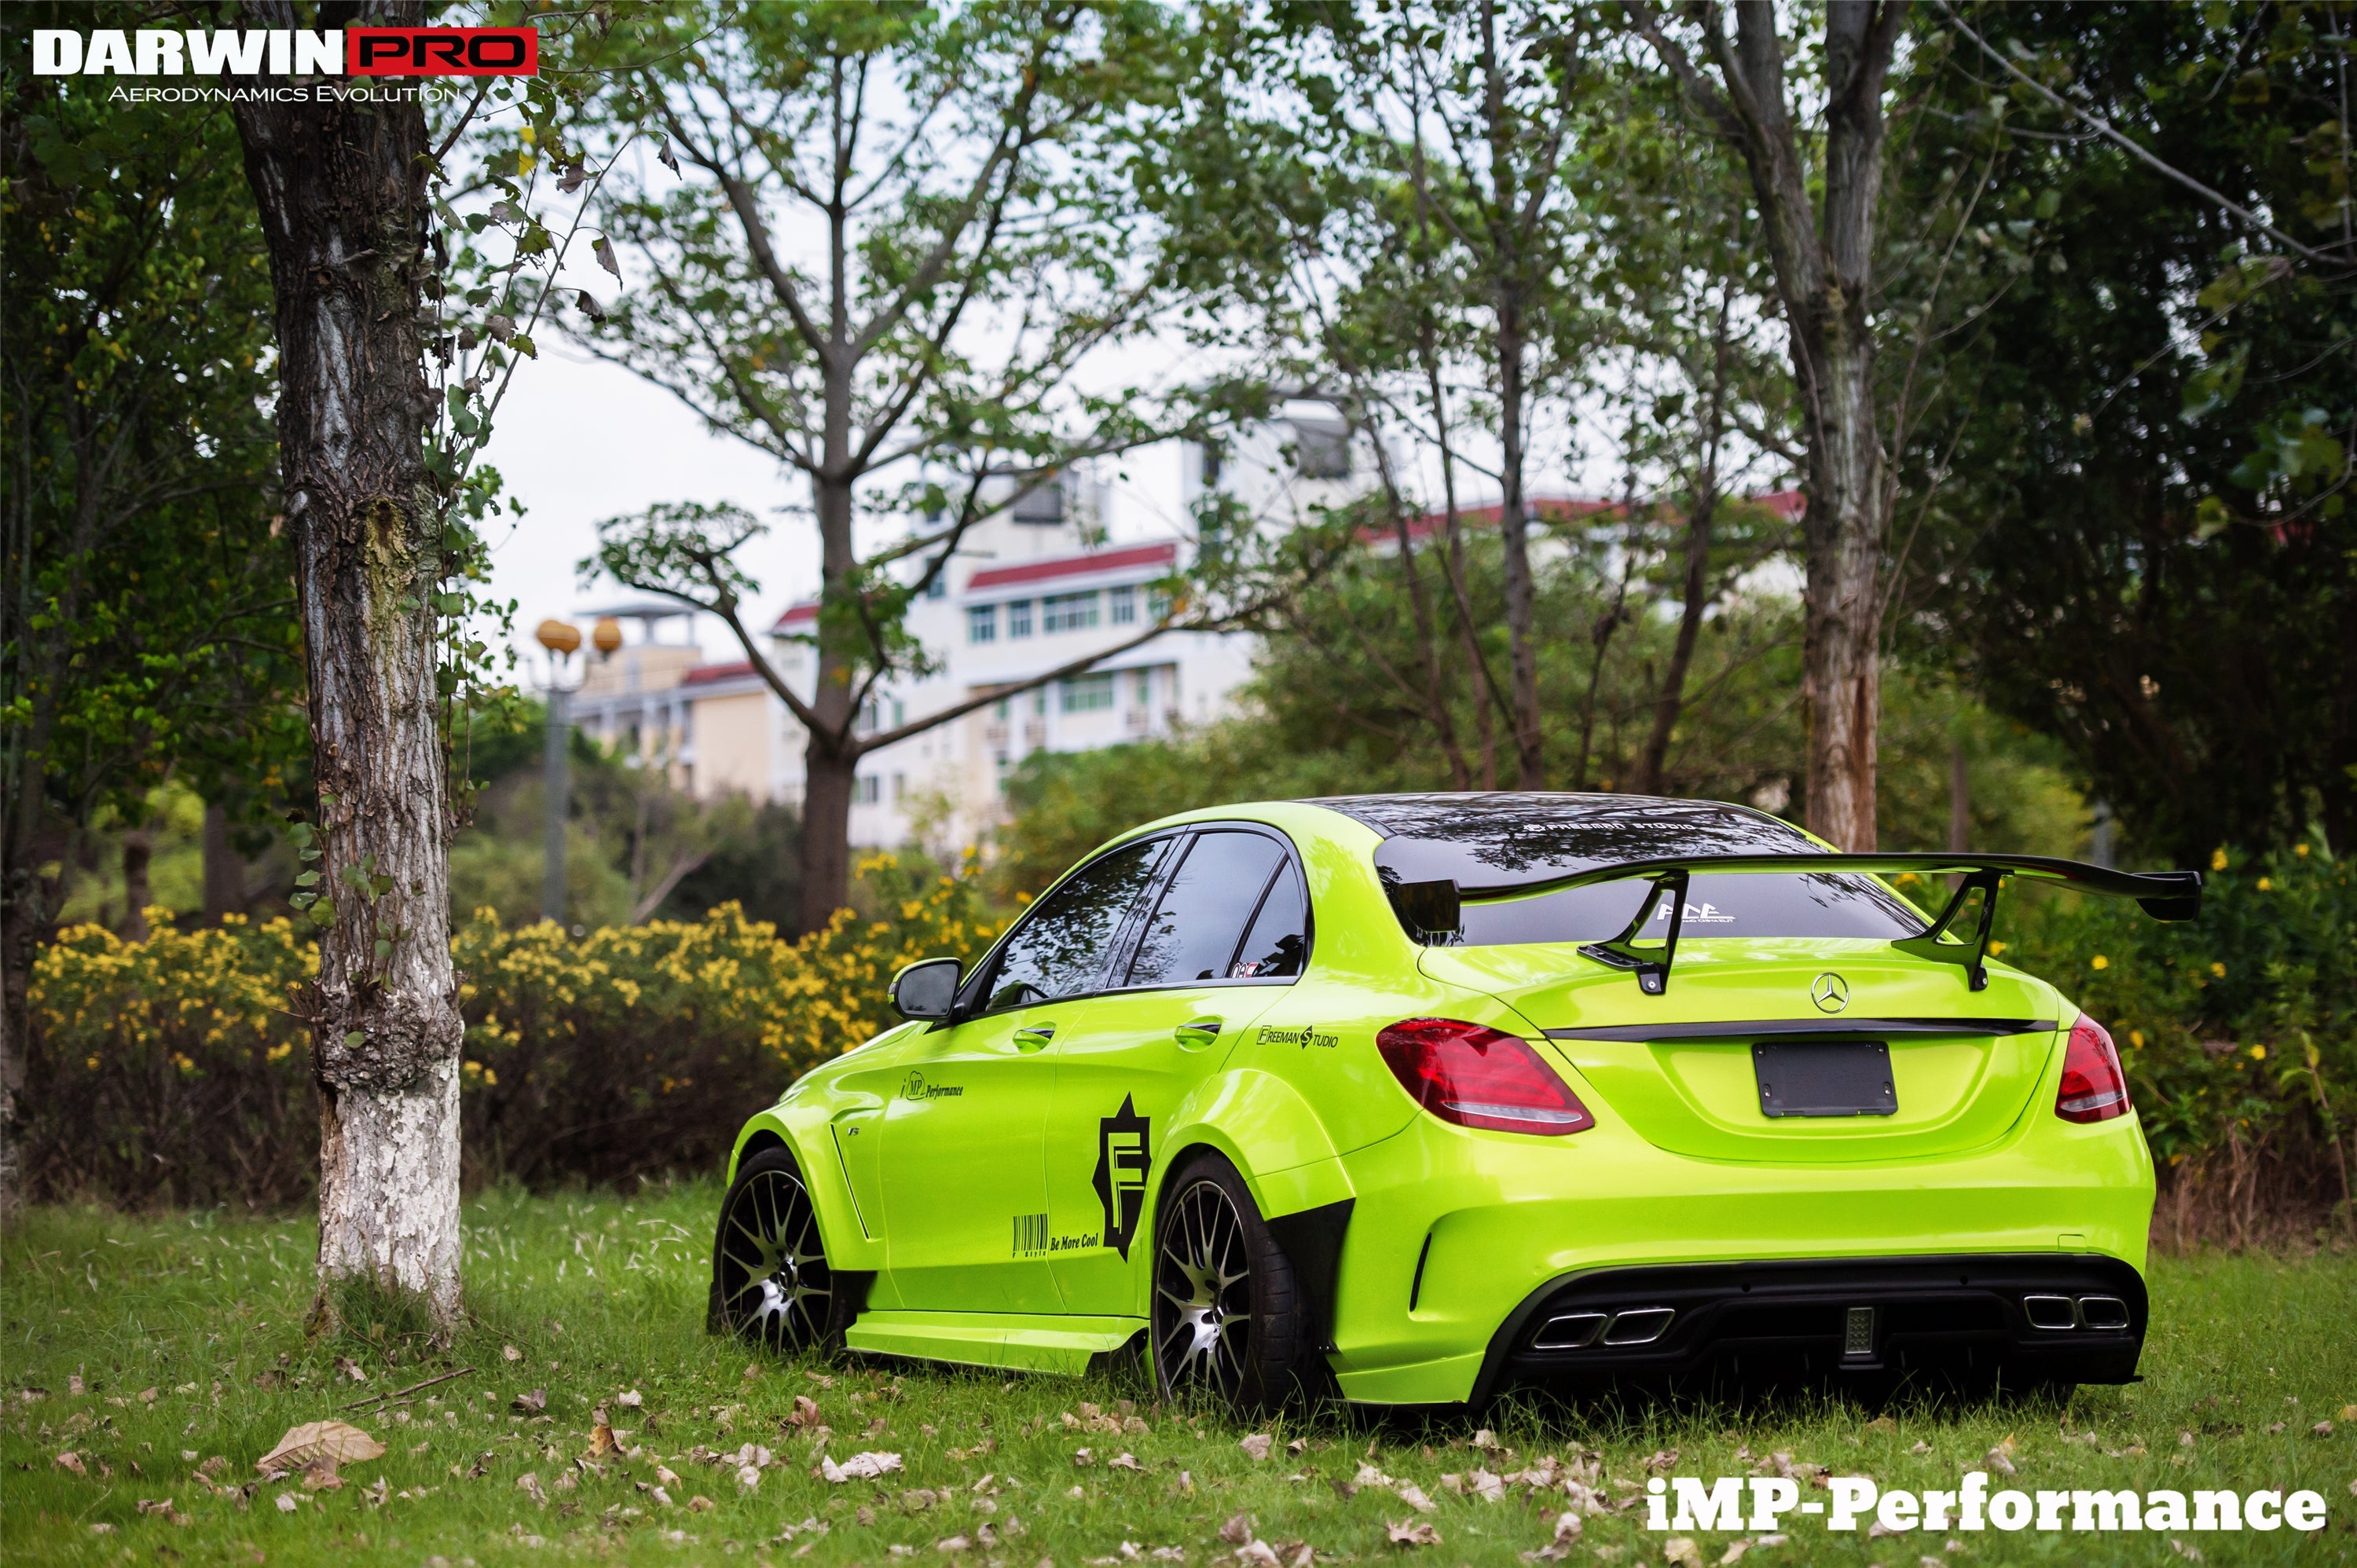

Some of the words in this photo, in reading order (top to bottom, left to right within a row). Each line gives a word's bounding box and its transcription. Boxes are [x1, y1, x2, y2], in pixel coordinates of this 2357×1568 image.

[926, 1084, 964, 1100] Performance
[1050, 1237, 1060, 1251] Be
[1061, 1236, 1080, 1251] More
[1081, 1233, 1099, 1248] Cool
